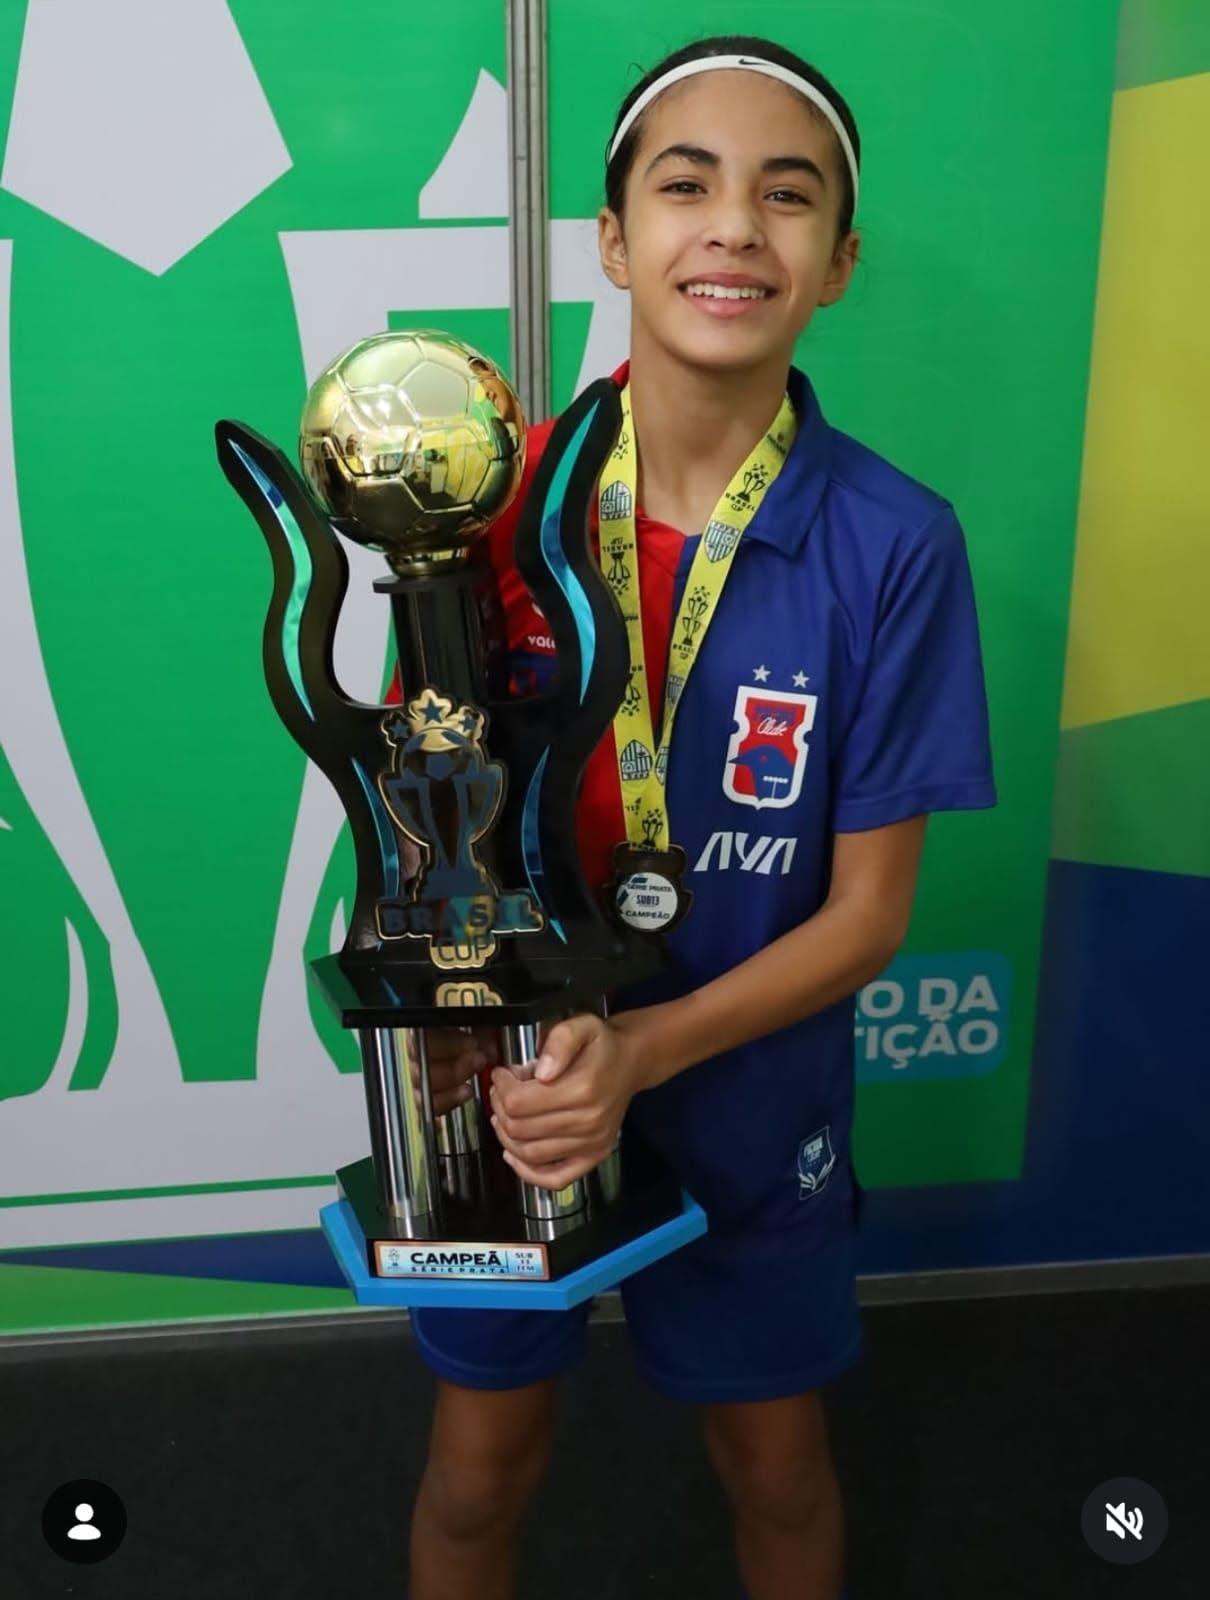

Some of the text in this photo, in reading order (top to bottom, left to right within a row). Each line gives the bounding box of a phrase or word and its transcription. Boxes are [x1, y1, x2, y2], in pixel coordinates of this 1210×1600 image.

[625, 910, 670, 920] CAMPEÃO
[438, 937, 493, 962] CUP
[918, 975, 999, 1017] DA
[411, 1250, 501, 1266] CAMPEÃ
